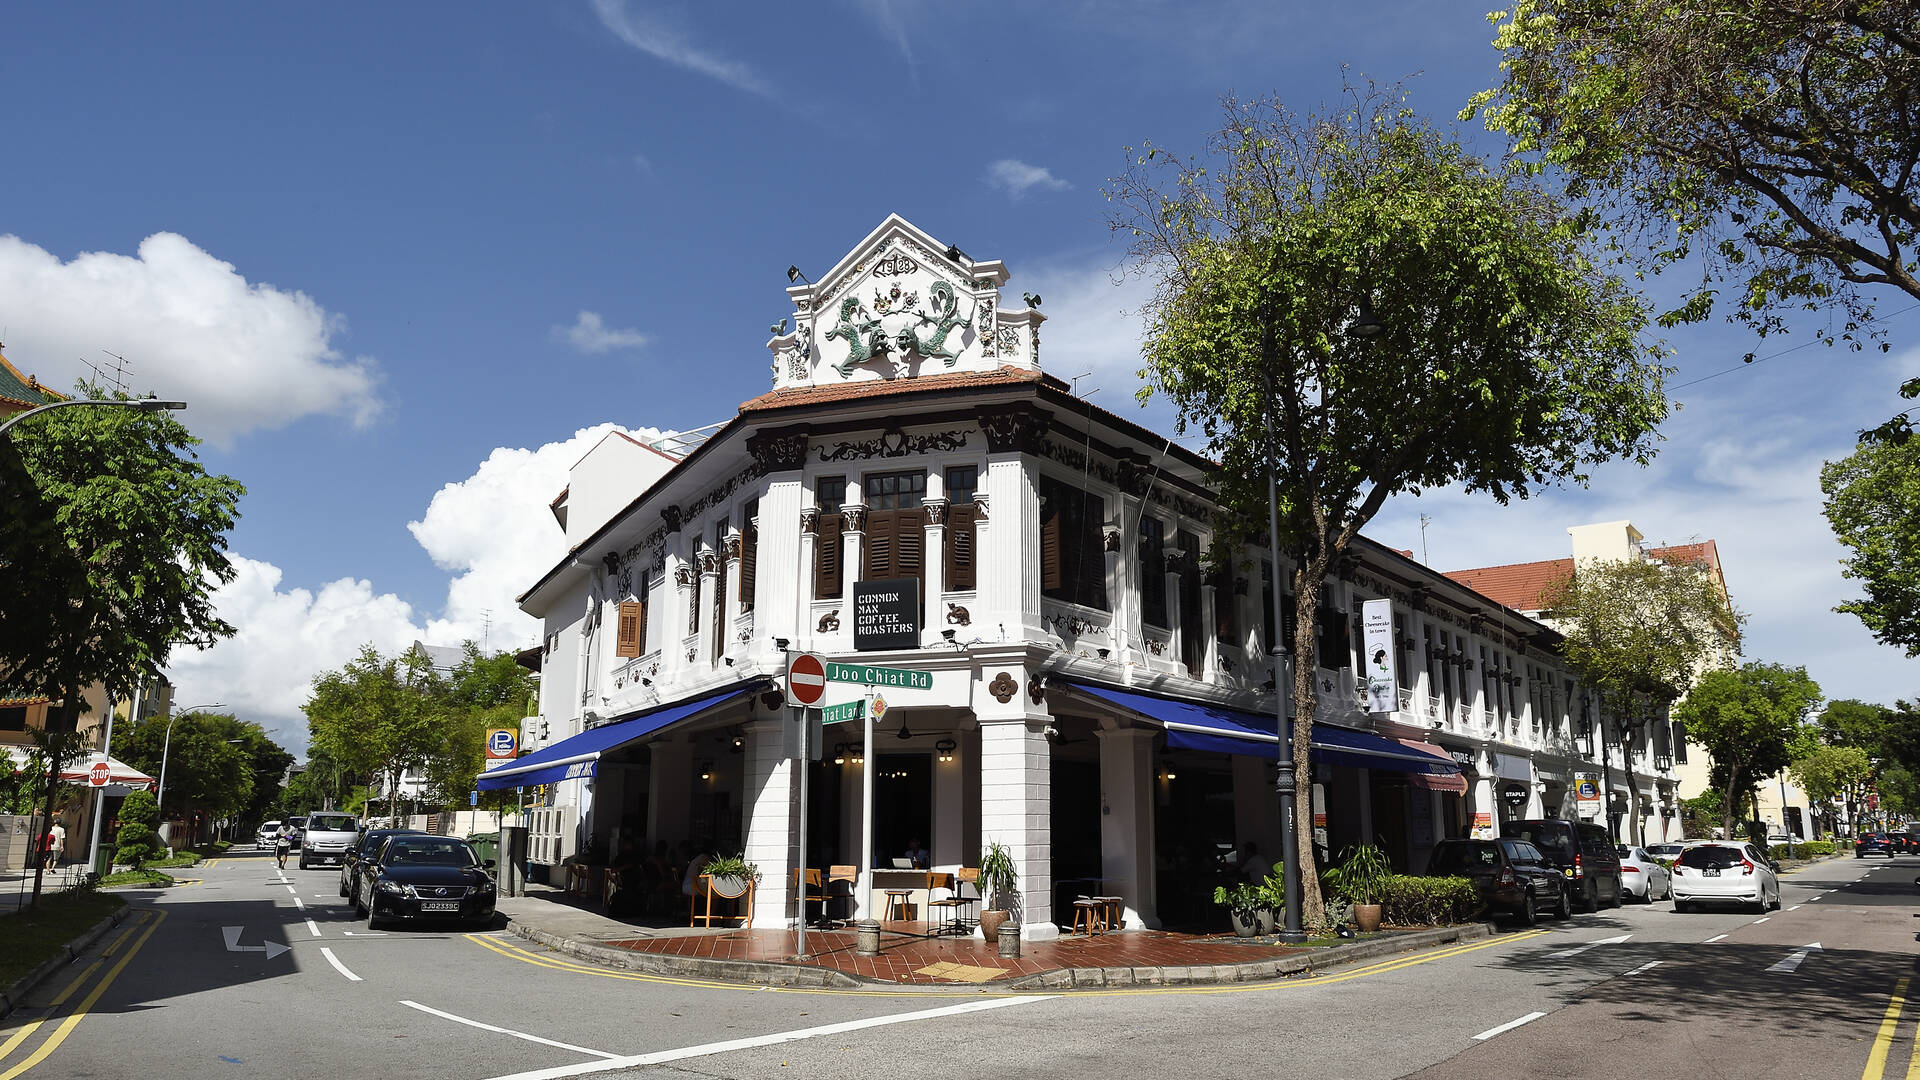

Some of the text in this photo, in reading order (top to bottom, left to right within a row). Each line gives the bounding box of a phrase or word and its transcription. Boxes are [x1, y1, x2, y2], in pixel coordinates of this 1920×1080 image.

[882, 260, 910, 272] 1928
[858, 592, 899, 604] COMMON
[858, 604, 879, 614] MAN
[858, 613, 900, 625] COFFEE
[858, 623, 913, 635] ROASTERS
[833, 665, 927, 687] Joo Chiat Rd
[822, 707, 840, 722] hiat
[90, 769, 110, 780] STOP
